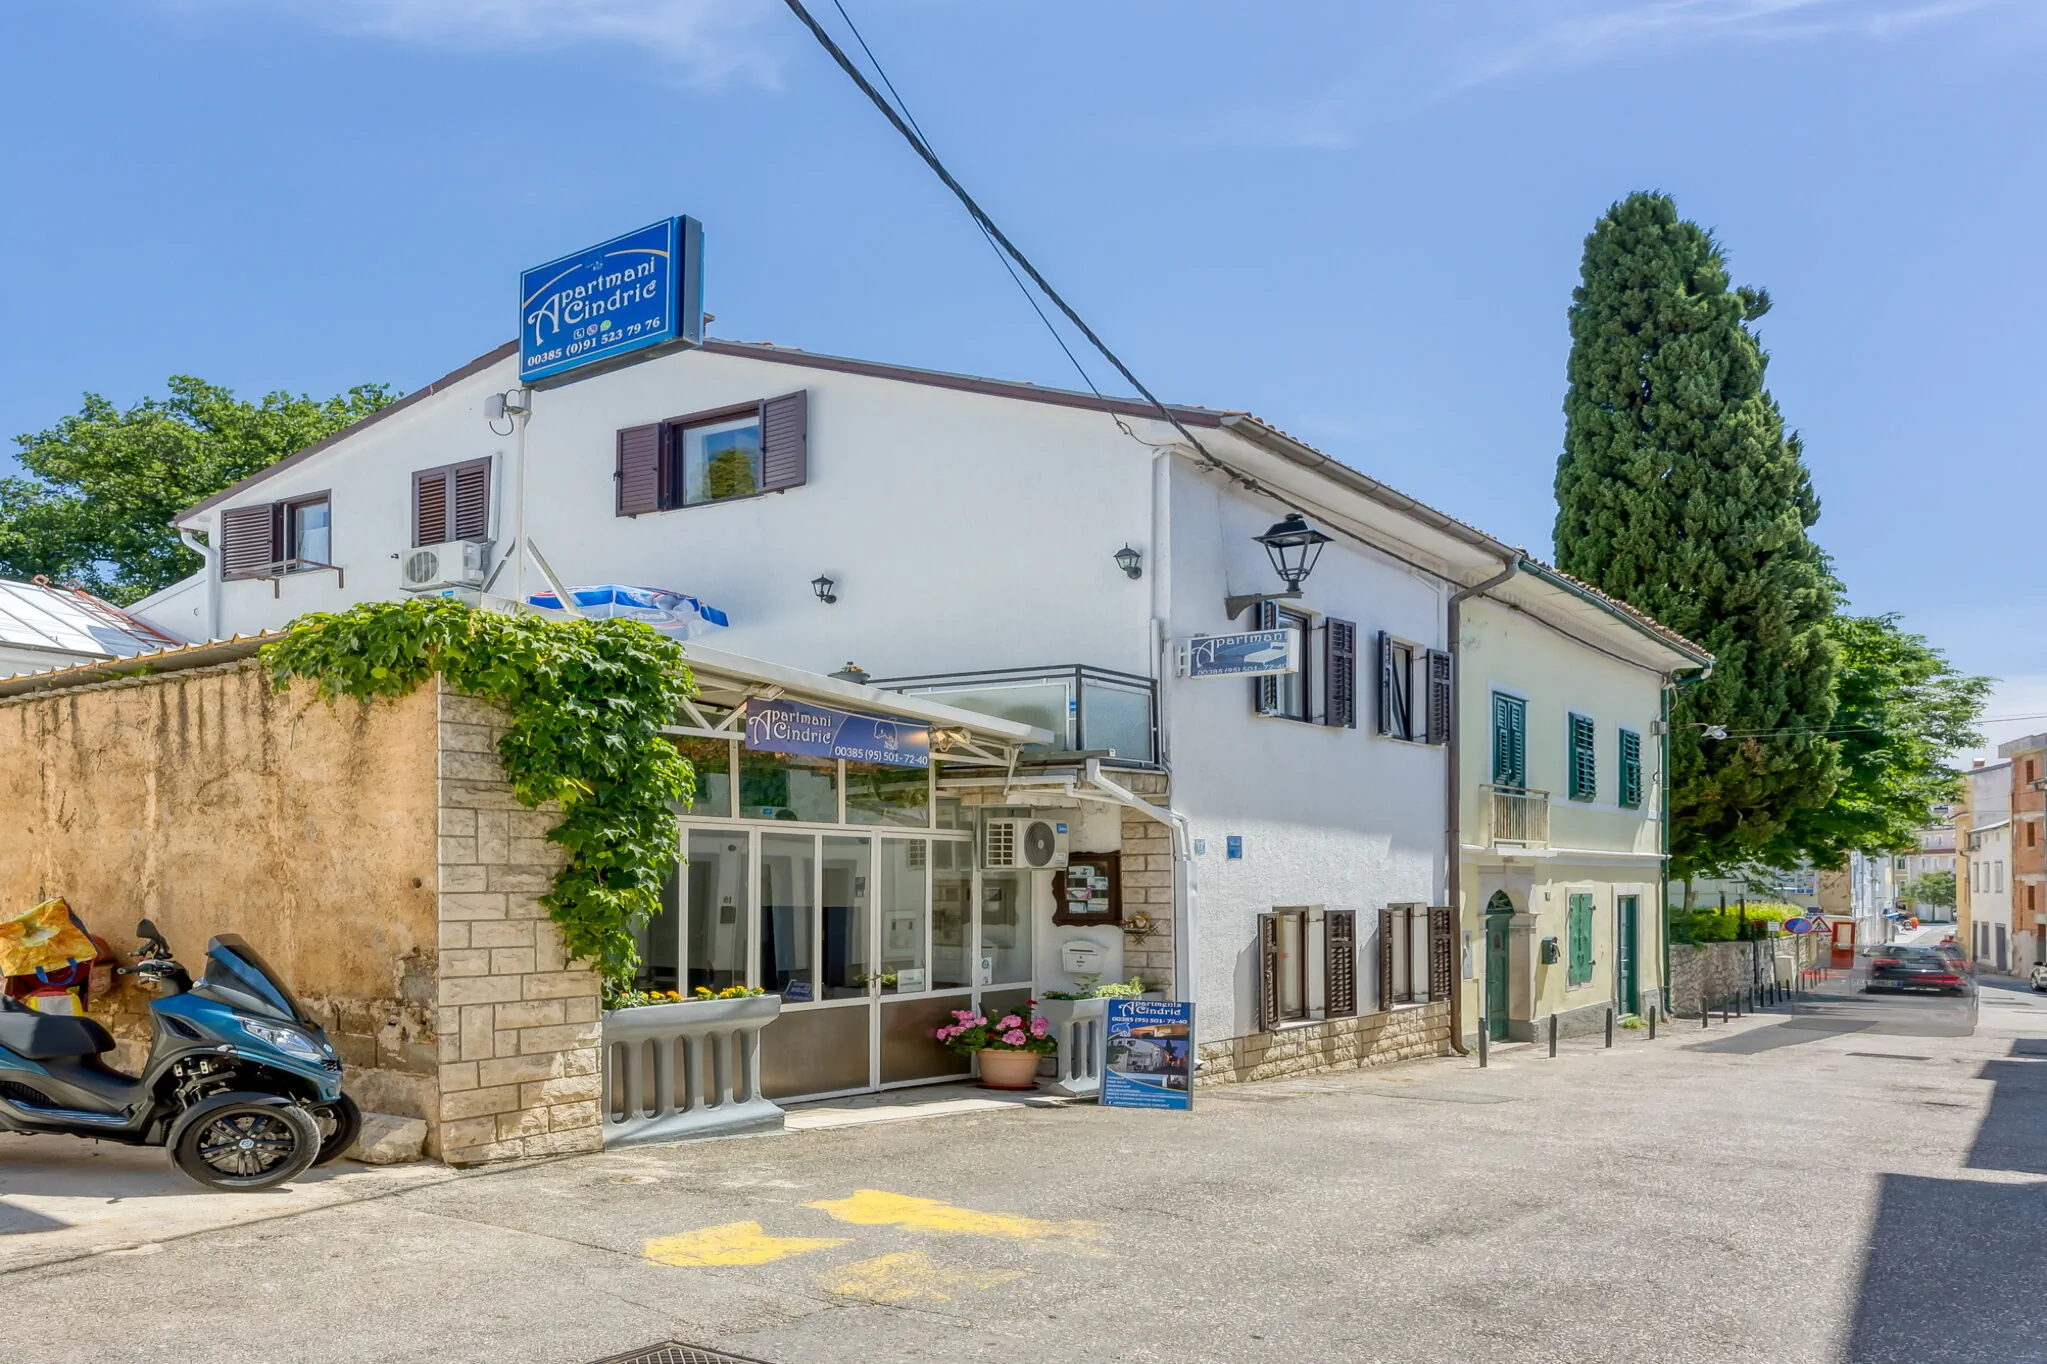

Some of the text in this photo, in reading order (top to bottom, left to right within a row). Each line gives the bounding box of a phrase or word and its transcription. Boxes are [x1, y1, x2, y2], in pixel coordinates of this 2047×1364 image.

[528, 257, 656, 346] Apartmani
[528, 316, 660, 367] 00385 (0)91 523 79 76
[1191, 632, 1288, 668] Apartmani
[749, 709, 831, 745] Apartmani
[835, 746, 864, 758] 00385
[865, 749, 882, 762] (95)
[904, 754, 928, 765] 72-40
